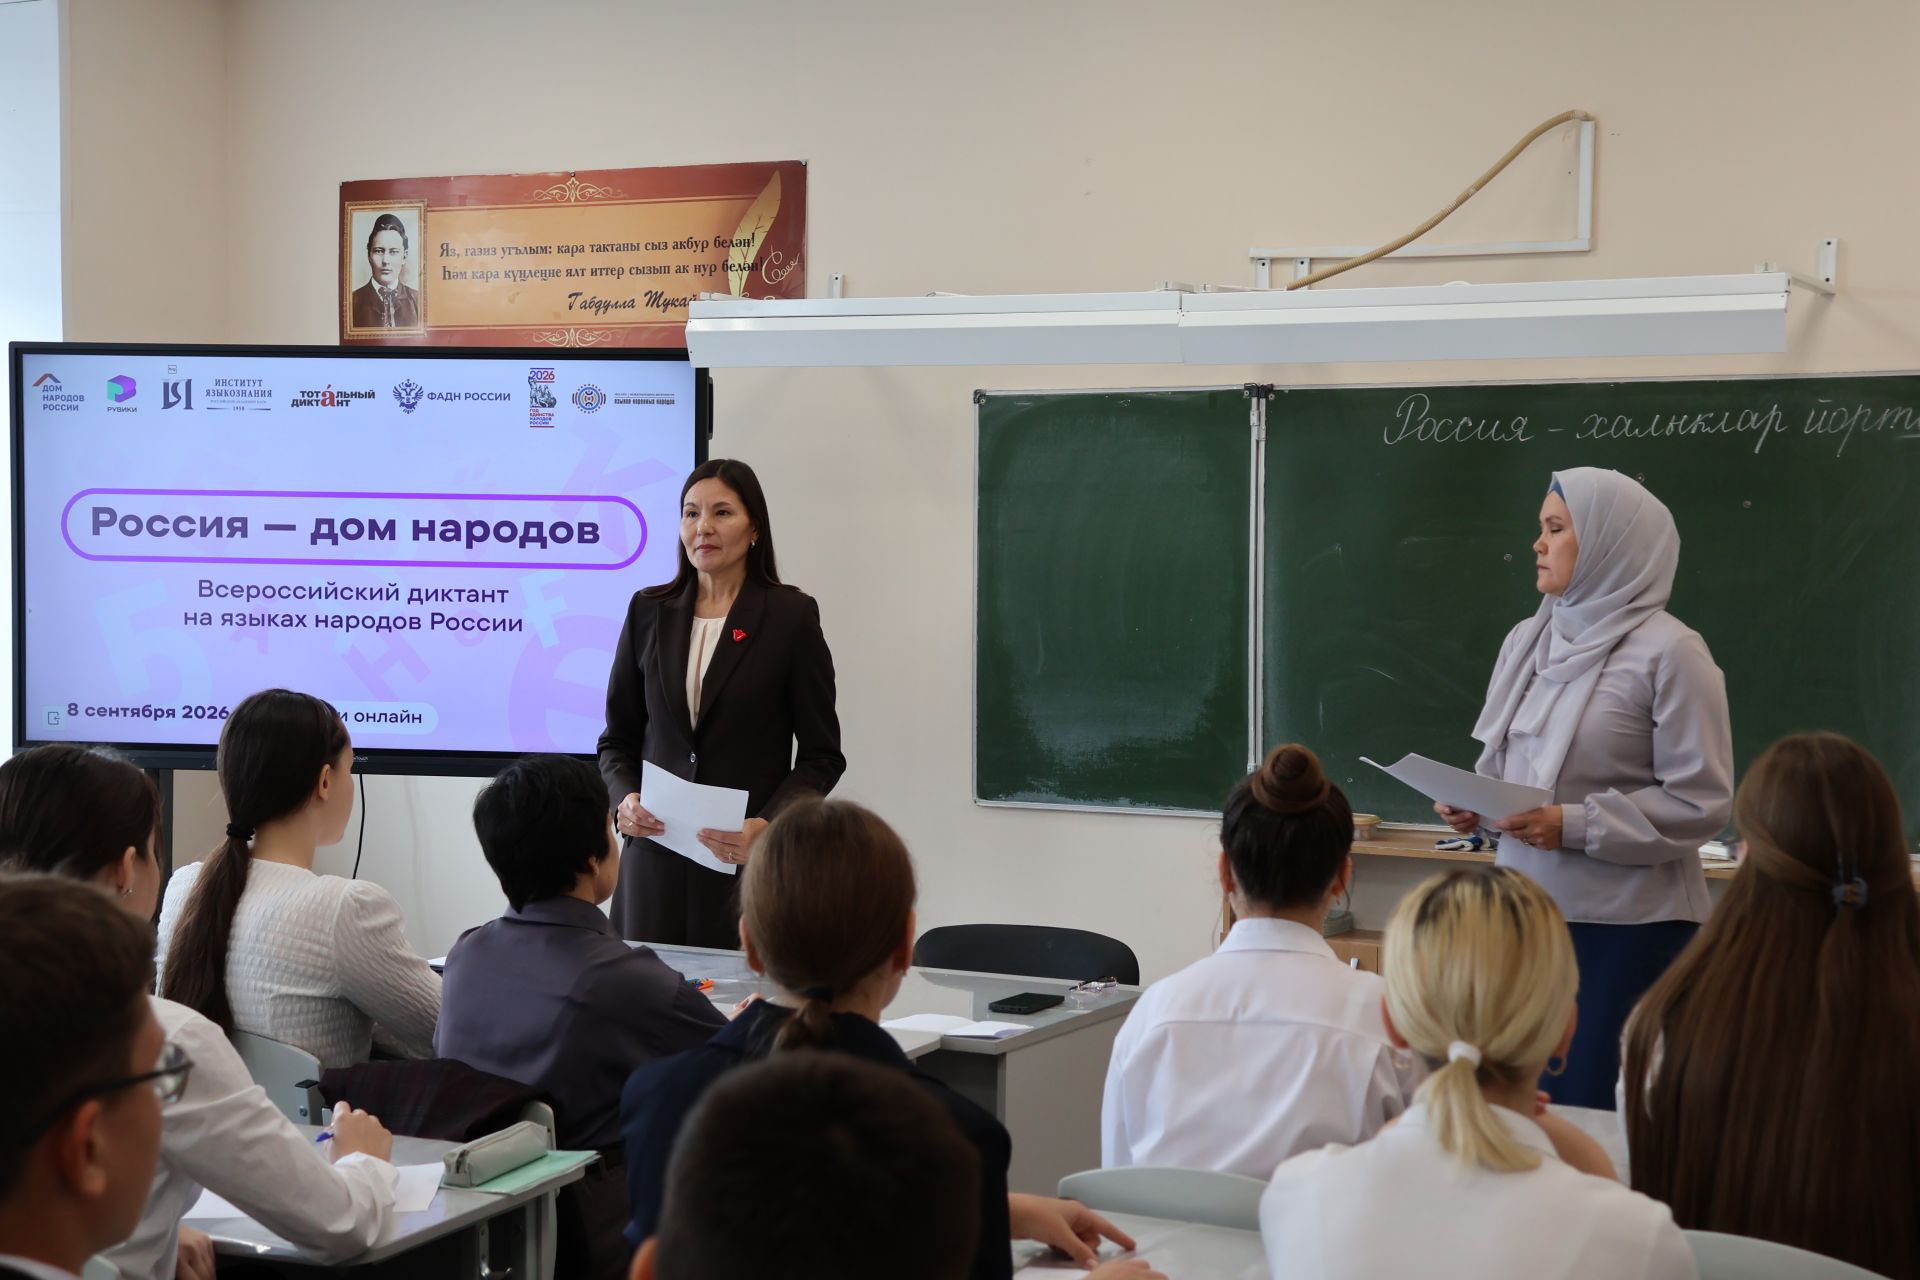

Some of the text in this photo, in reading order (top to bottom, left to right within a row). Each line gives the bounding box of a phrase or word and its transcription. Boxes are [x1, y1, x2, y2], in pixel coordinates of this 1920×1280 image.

[440, 242, 460, 258] Яз,
[465, 246, 497, 257] газиз
[557, 244, 585, 257] кара
[589, 240, 640, 253] тактаны
[644, 241, 668, 251] сыз
[672, 236, 709, 253] акбур
[714, 232, 755, 248] белән!
[472, 270, 499, 283] кара
[566, 267, 586, 278] ялт
[591, 265, 625, 279] иттер
[629, 264, 671, 275] сызып
[675, 264, 689, 274] ак
[694, 262, 717, 278] нур
[722, 256, 763, 272] белән!
[568, 292, 635, 316] Габдулла
[214, 378, 263, 387] ИНСТИТУТ
[530, 370, 555, 381] 2026
[42, 384, 63, 392] ДОМ
[205, 388, 273, 398] ЯЗЫКОЗНАНИЯ
[427, 391, 511, 402] ФАДН РОССИИ
[42, 394, 85, 402] НАРОДОВ
[42, 403, 79, 411] РОССИИ
[1383, 393, 1535, 445] Россия
[1576, 403, 1788, 454] халыклар
[1803, 398, 1920, 458] йорт
[91, 506, 249, 539] Россия
[310, 517, 396, 546] дом
[412, 519, 600, 549] народов
[198, 579, 509, 605] Всероссийский диктант
[184, 611, 523, 633] на языках народов России
[67, 702, 229, 721] 8 сентября 2026
[354, 709, 422, 724] онлайн
